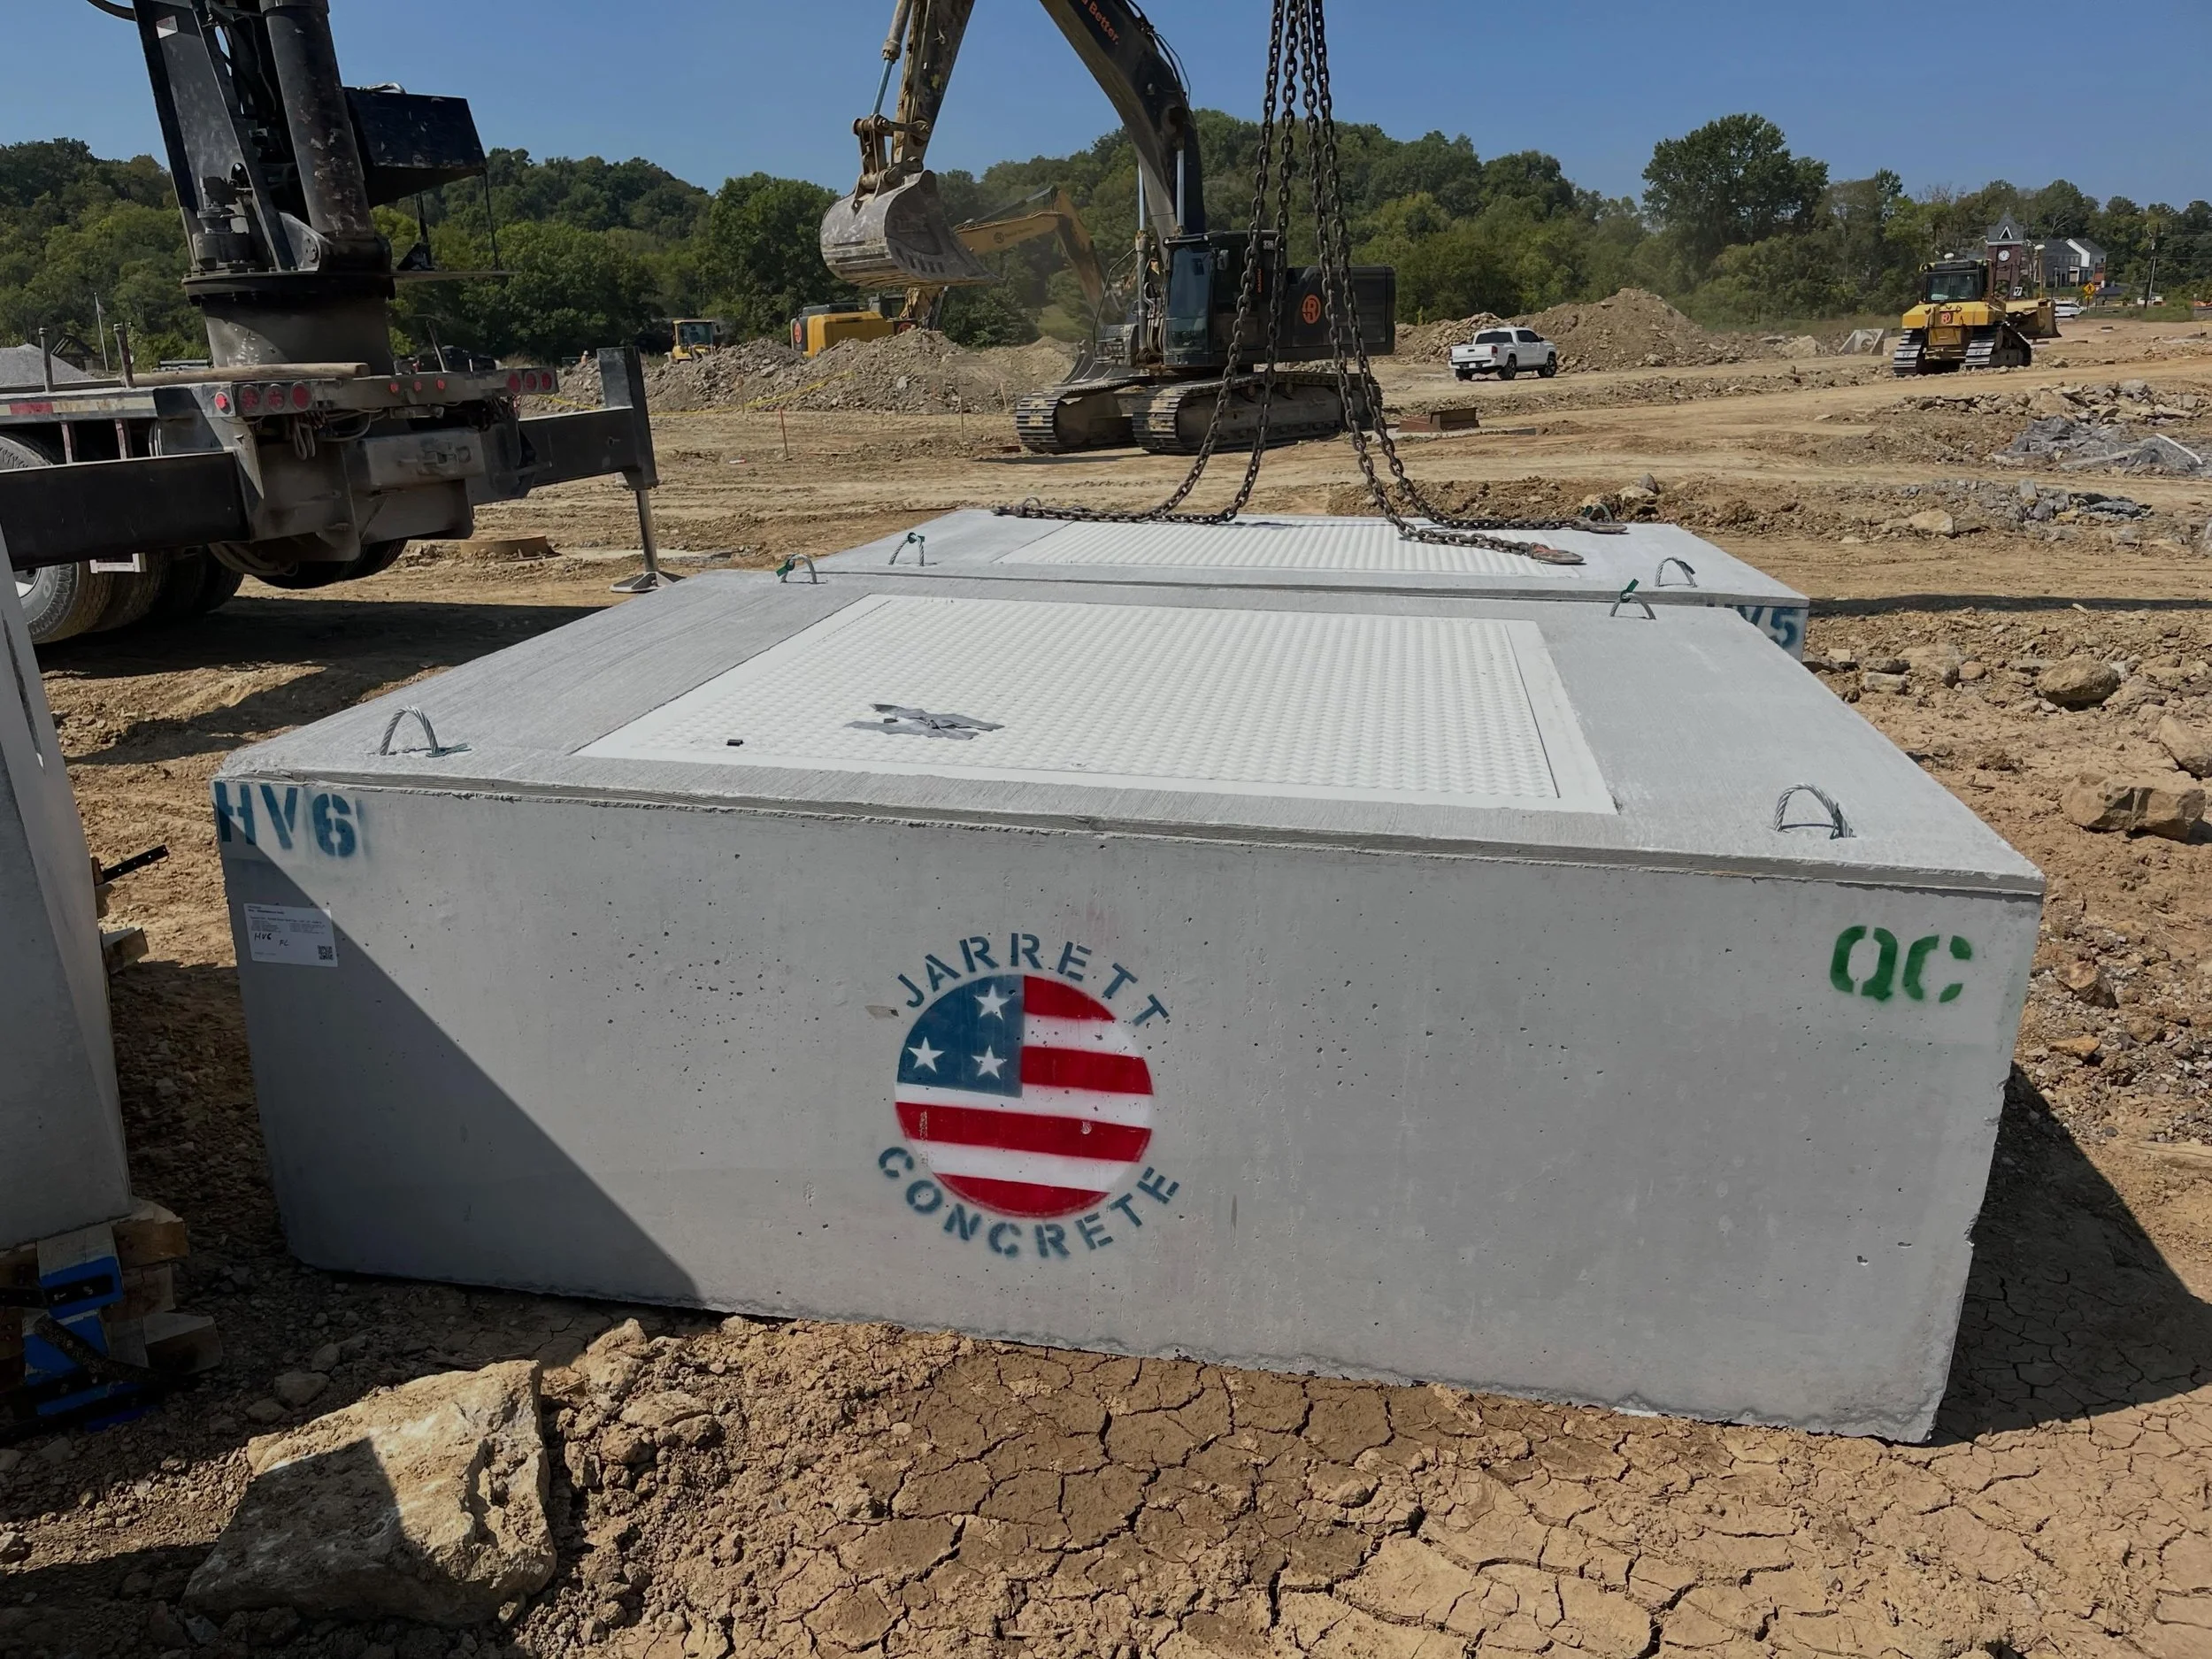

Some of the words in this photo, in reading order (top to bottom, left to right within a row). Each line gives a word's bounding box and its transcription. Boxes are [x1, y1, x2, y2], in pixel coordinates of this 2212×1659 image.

[213, 780, 357, 857] HV6
[896, 932, 1170, 1026] JARRETT
[1830, 925, 1973, 1003] QC
[878, 1146, 1180, 1259] CONCRETE
